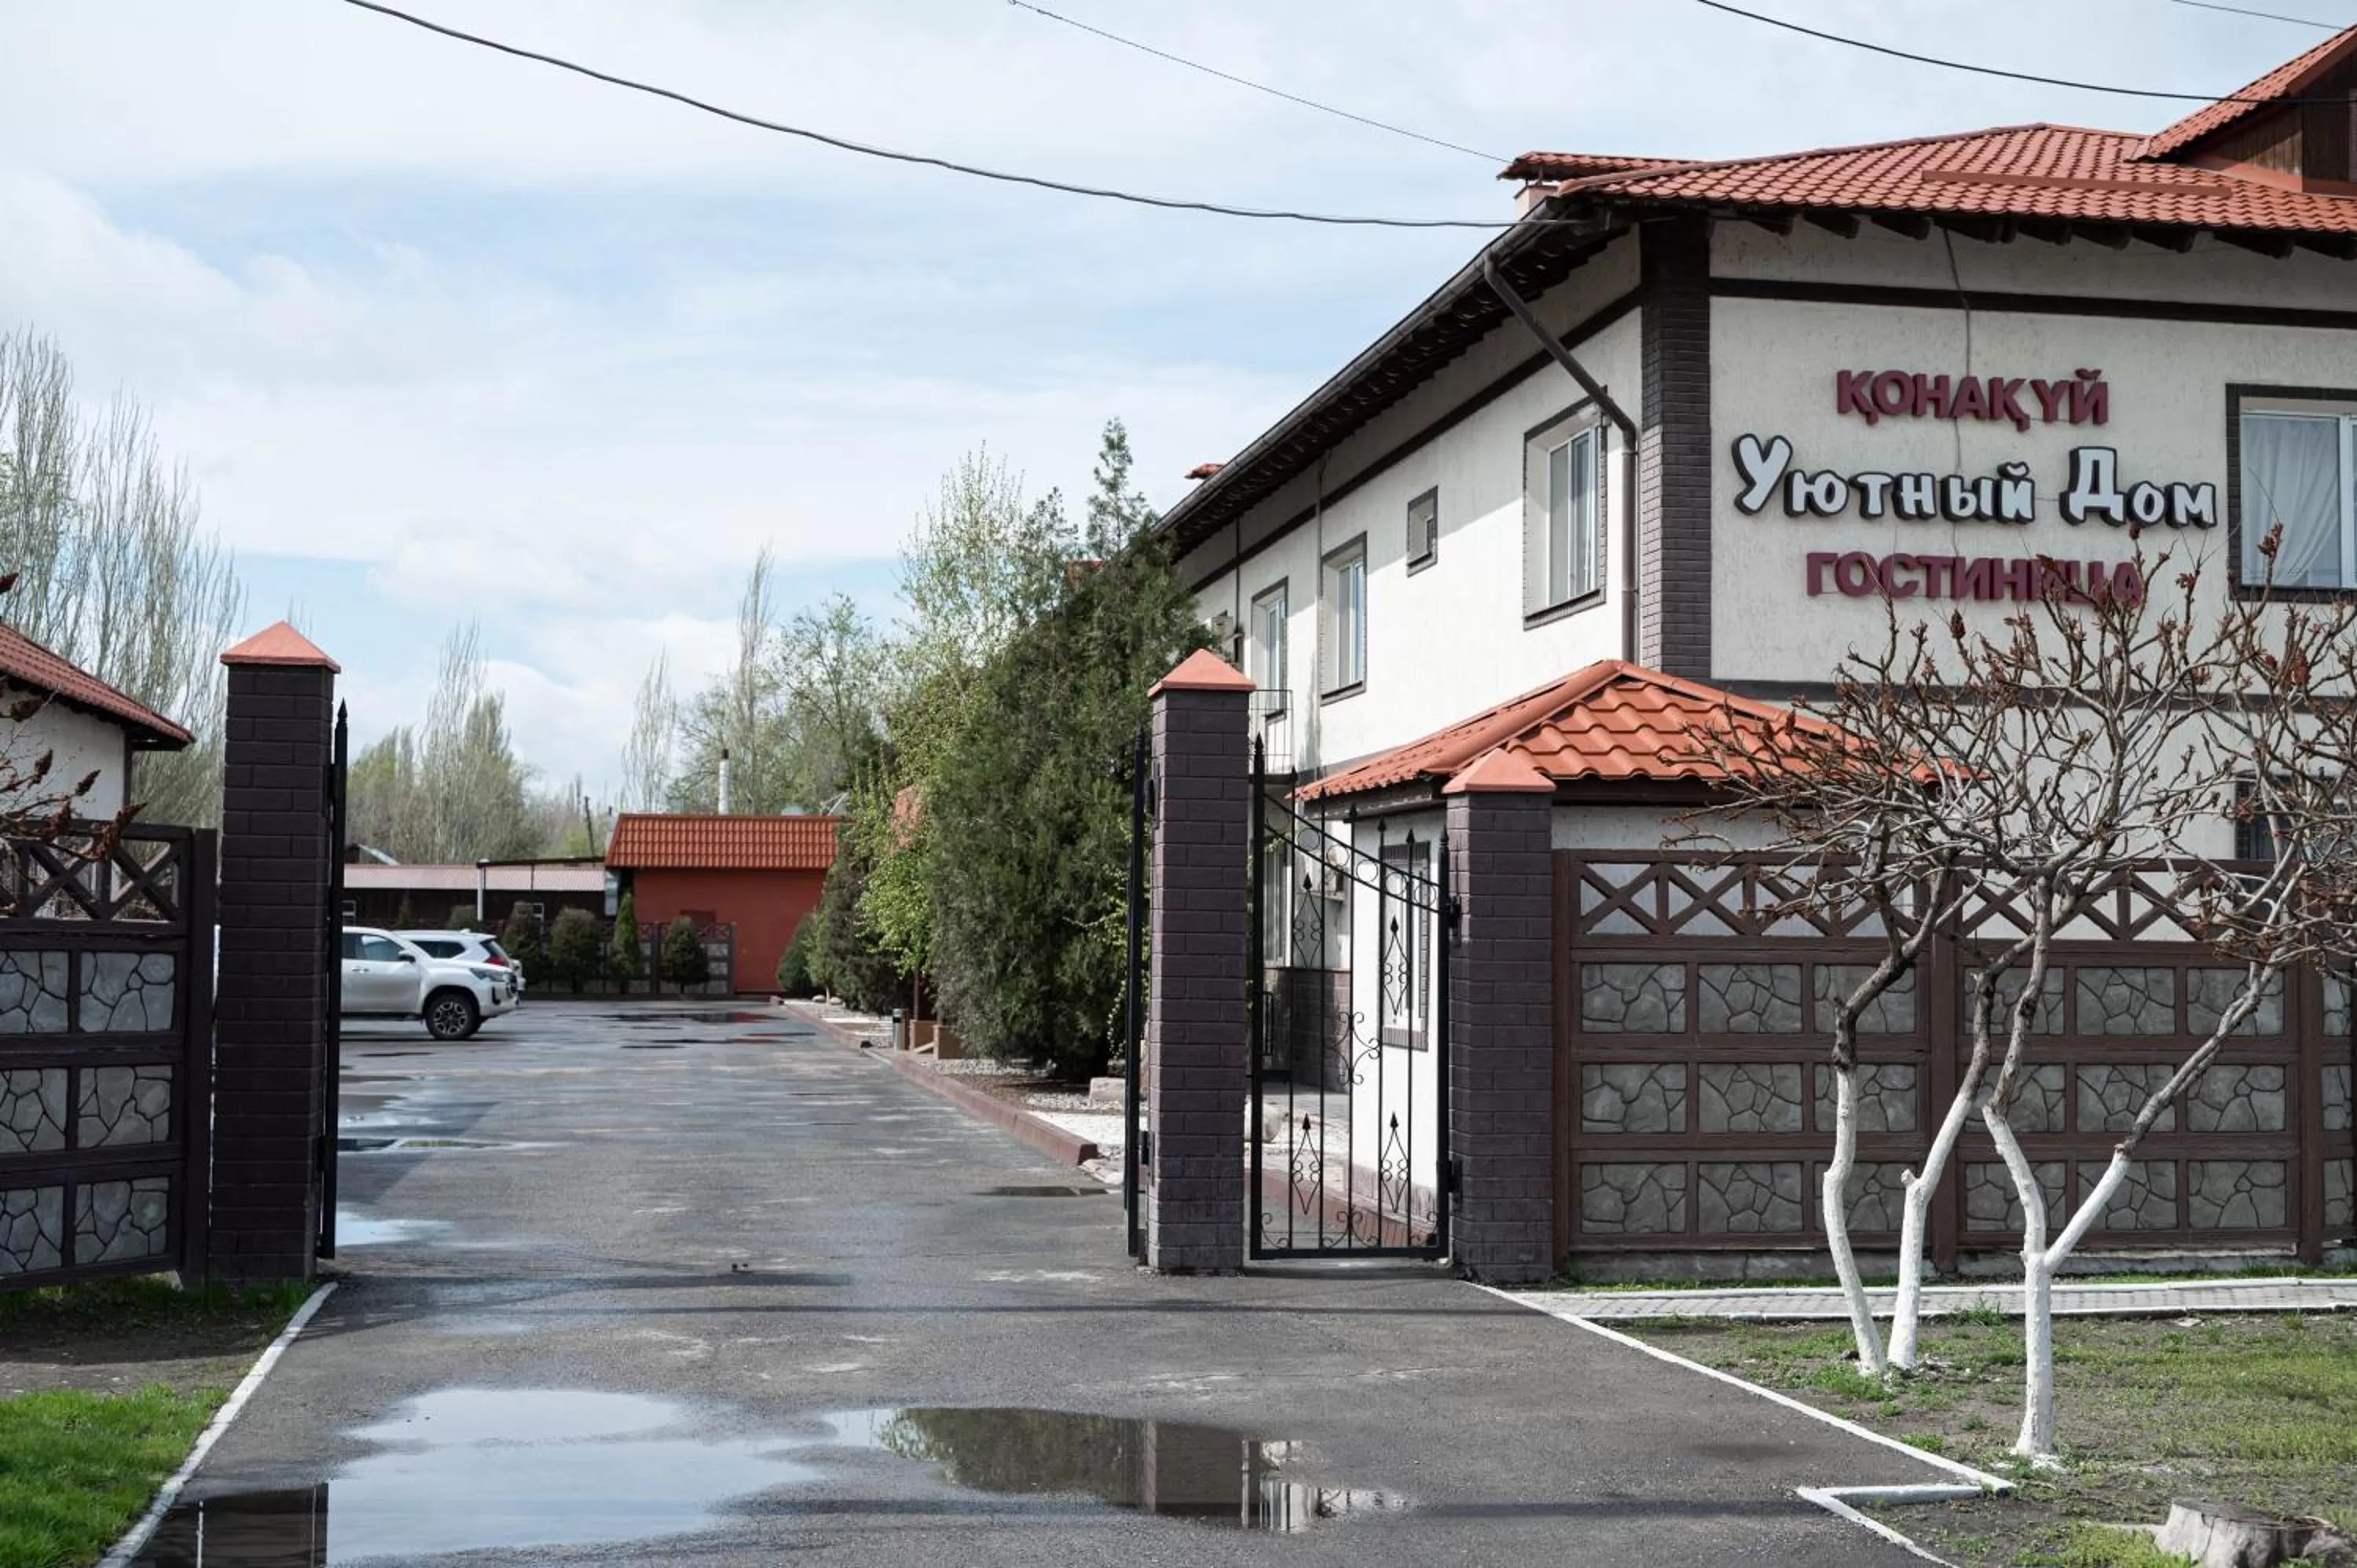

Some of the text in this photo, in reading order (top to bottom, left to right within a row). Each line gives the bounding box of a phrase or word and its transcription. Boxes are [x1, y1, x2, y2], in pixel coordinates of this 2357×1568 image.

[1732, 433, 2218, 529] Уютный Дом
[1806, 551, 2143, 608] ГОСТИНИЦА
